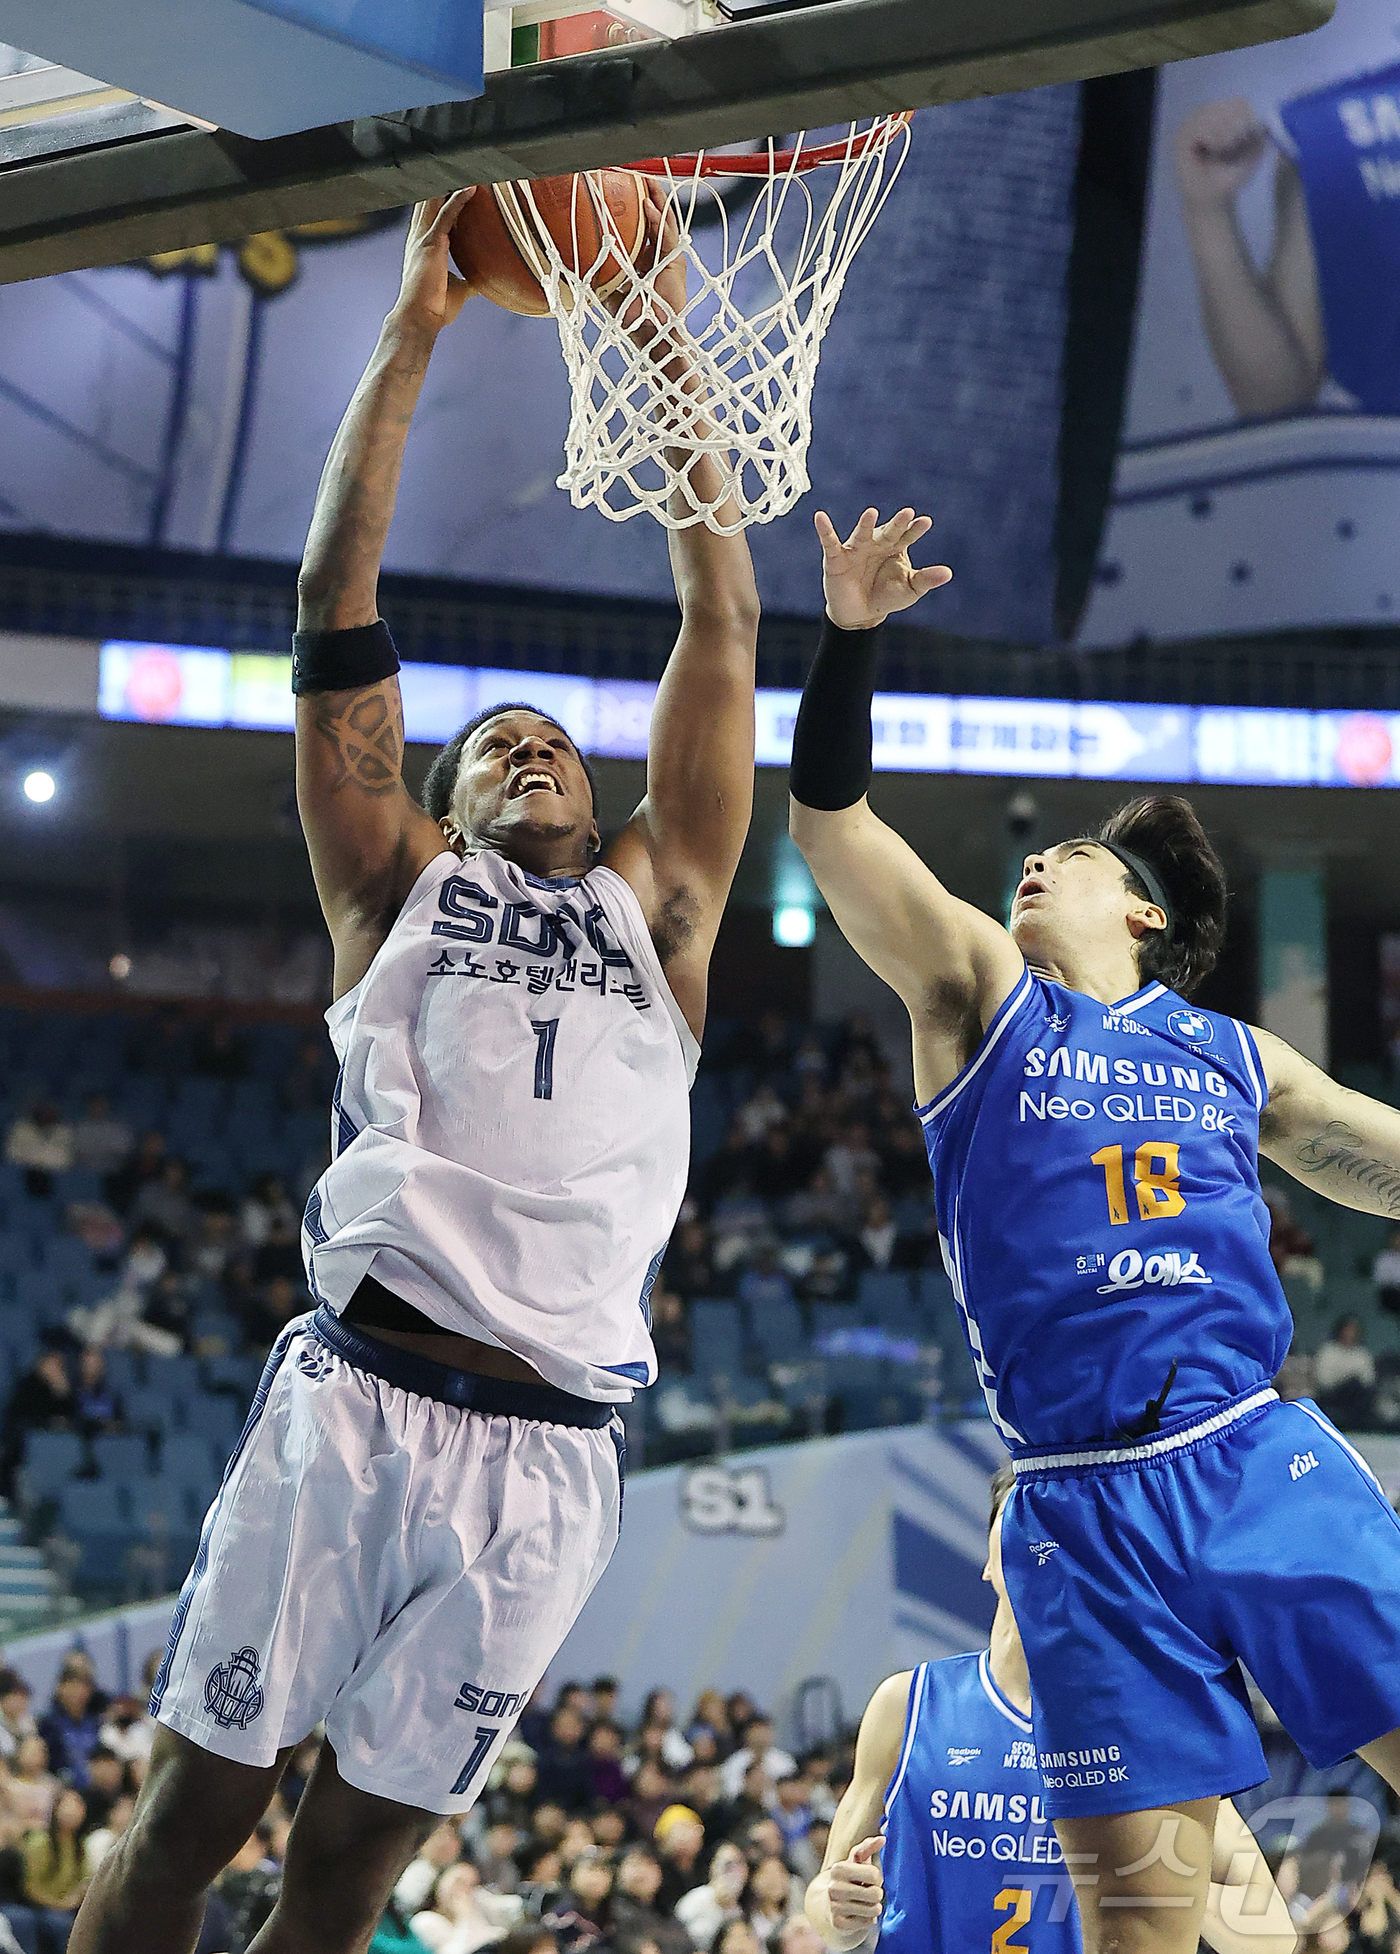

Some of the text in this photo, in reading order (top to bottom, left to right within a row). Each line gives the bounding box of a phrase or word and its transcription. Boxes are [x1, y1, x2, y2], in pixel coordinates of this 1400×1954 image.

[531, 1018, 560, 1101] 1
[1024, 1046, 1229, 1099] SAMSUNG
[1019, 1091, 1236, 1138] Neo QLED 8K
[1090, 1141, 1188, 1227] 18
[1096, 1249, 1214, 1295] 오예스
[684, 1467, 780, 1530] S1
[449, 1727, 500, 1795] 1
[1040, 1746, 1121, 1769] SAMSUNG
[1042, 1766, 1130, 1789] Neo QLED 8K
[932, 1830, 1065, 1864] Neo QLED
[991, 1888, 1033, 1954] 2
